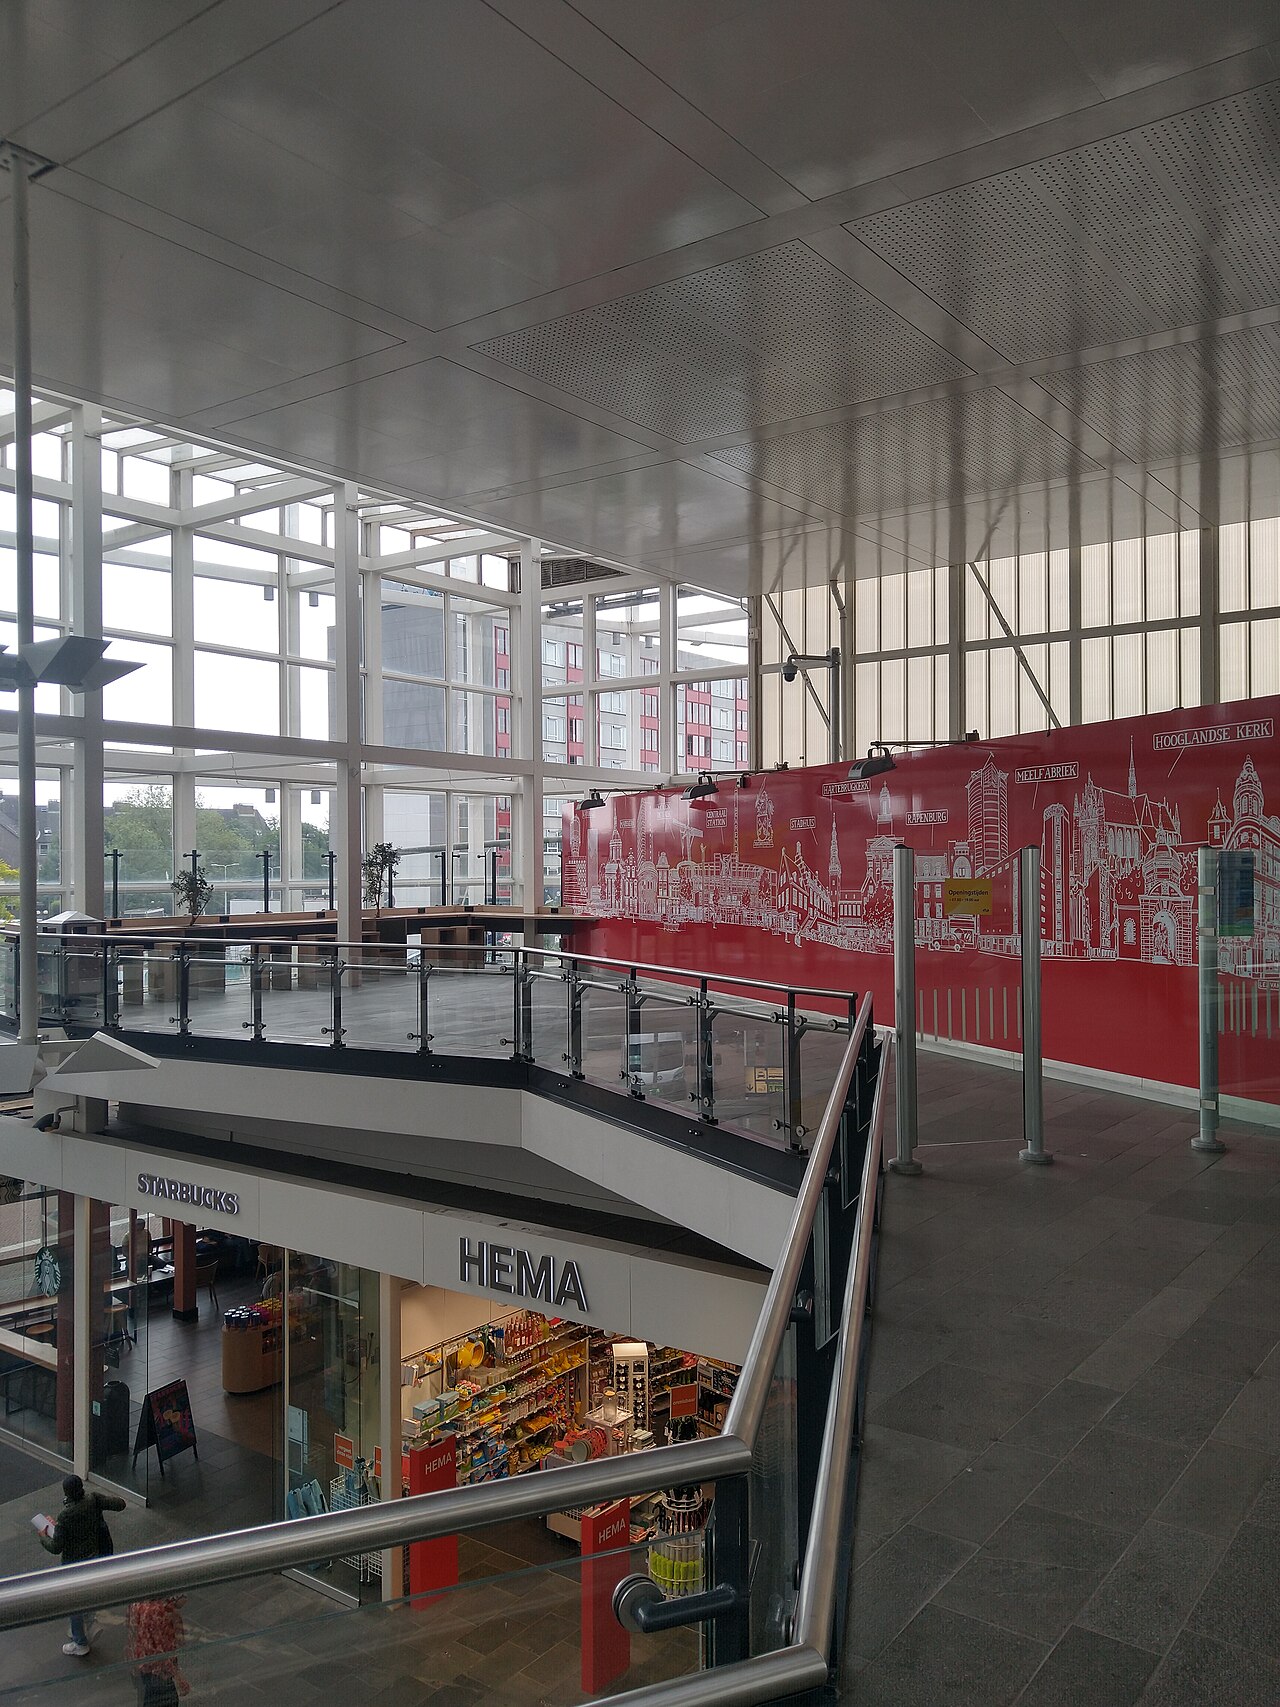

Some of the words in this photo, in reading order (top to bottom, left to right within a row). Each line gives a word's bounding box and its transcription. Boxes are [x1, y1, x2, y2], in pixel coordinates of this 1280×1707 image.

[1155, 727, 1231, 749] HOOGLANDSE
[1236, 721, 1271, 739] KERK
[1016, 763, 1077, 782] MEELFABRIEK
[907, 811, 947, 824] RAPENBURG
[948, 889, 989, 897] Openingstijden
[138, 1173, 239, 1215] STARBUCKS
[459, 1236, 588, 1312] HEMA
[425, 1453, 453, 1475] HEMA
[598, 1517, 626, 1544] HEMA
